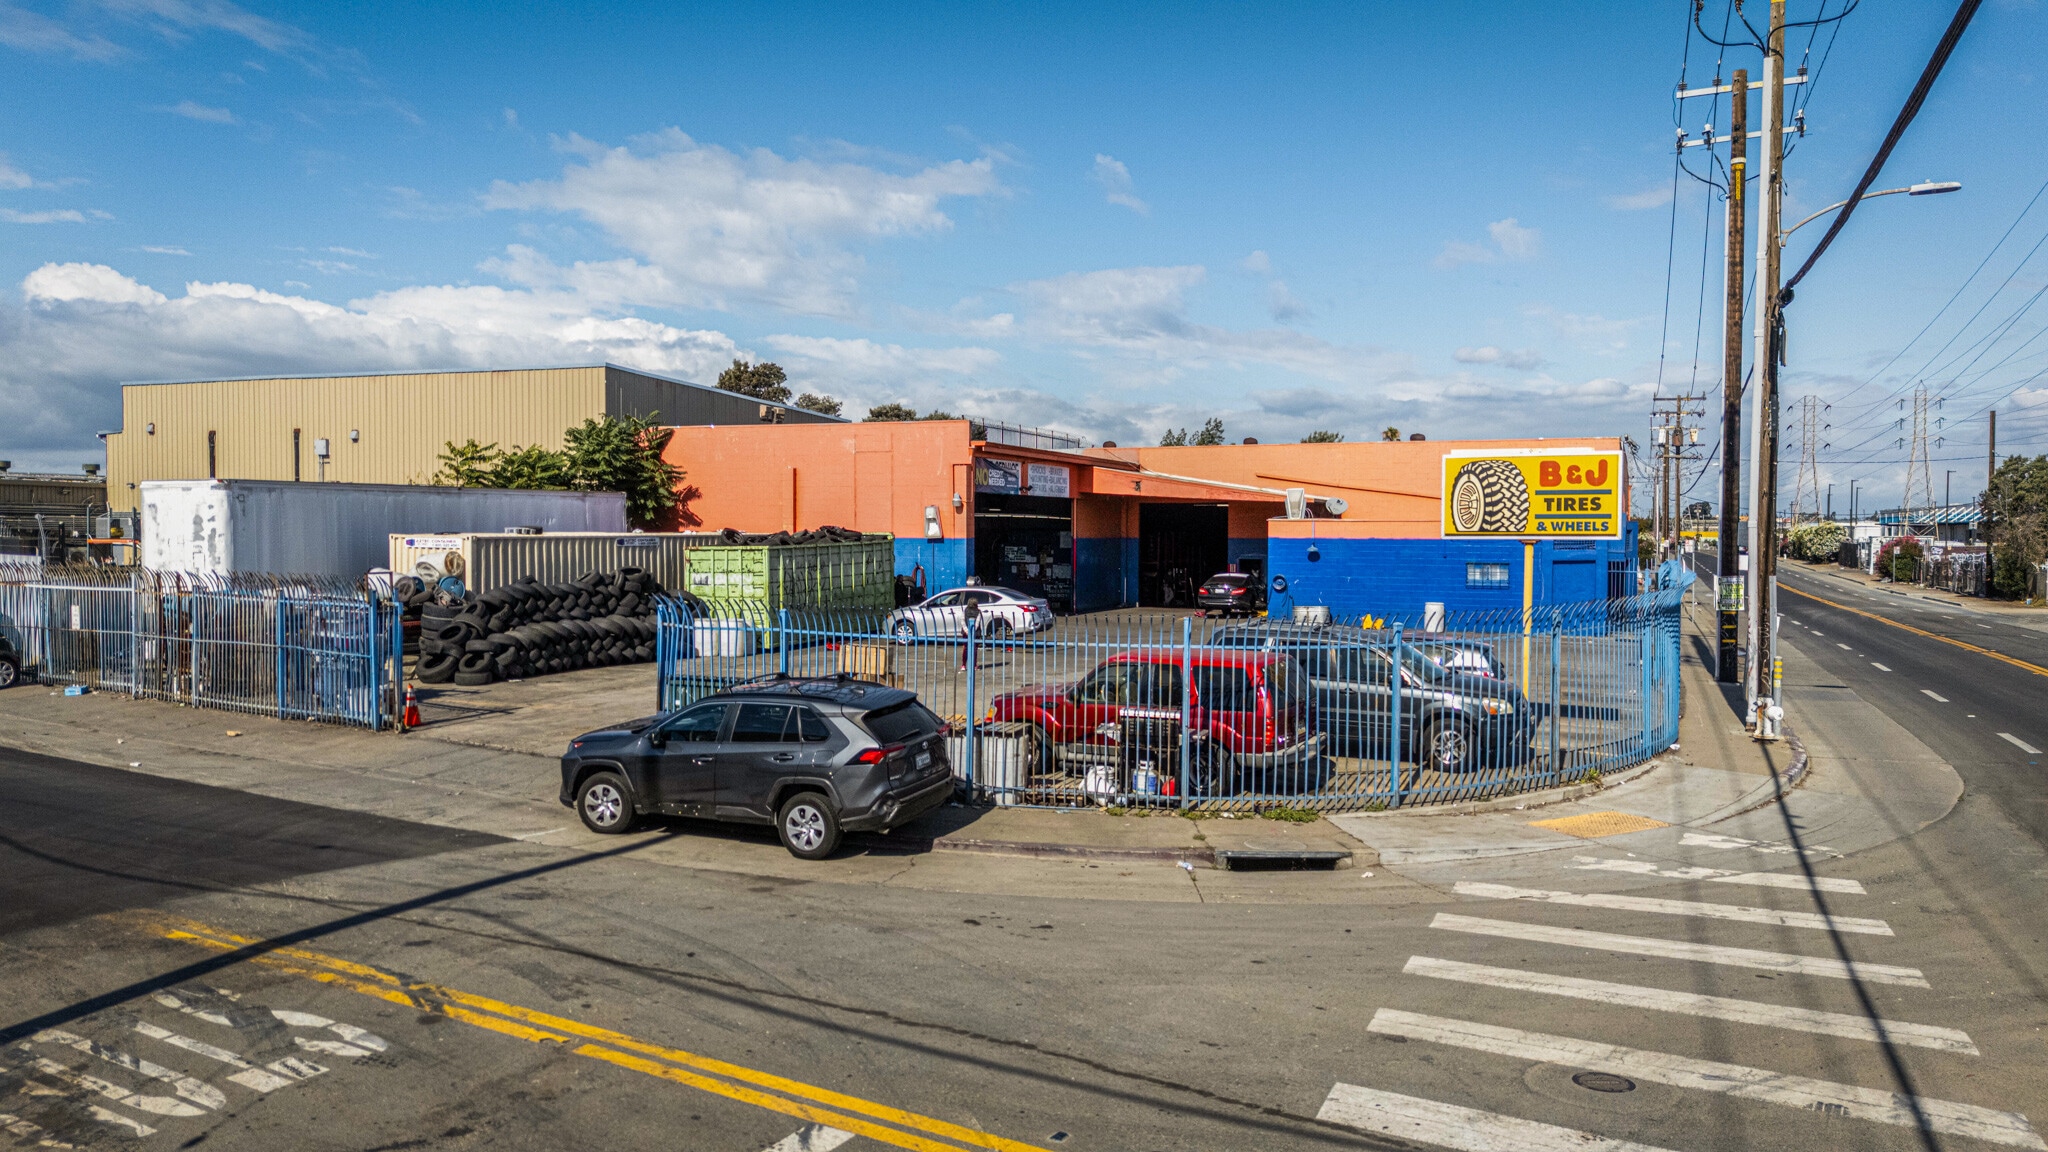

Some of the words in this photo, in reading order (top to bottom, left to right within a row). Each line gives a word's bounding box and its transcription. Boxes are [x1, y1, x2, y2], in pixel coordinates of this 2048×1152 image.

[975, 468, 989, 485] NO
[989, 469, 1004, 478] CREDIT
[989, 478, 1006, 487] NEEDED
[1544, 497, 1602, 512] TIRES
[1536, 521, 1548, 532] &
[1552, 521, 1609, 532] WHEELS
